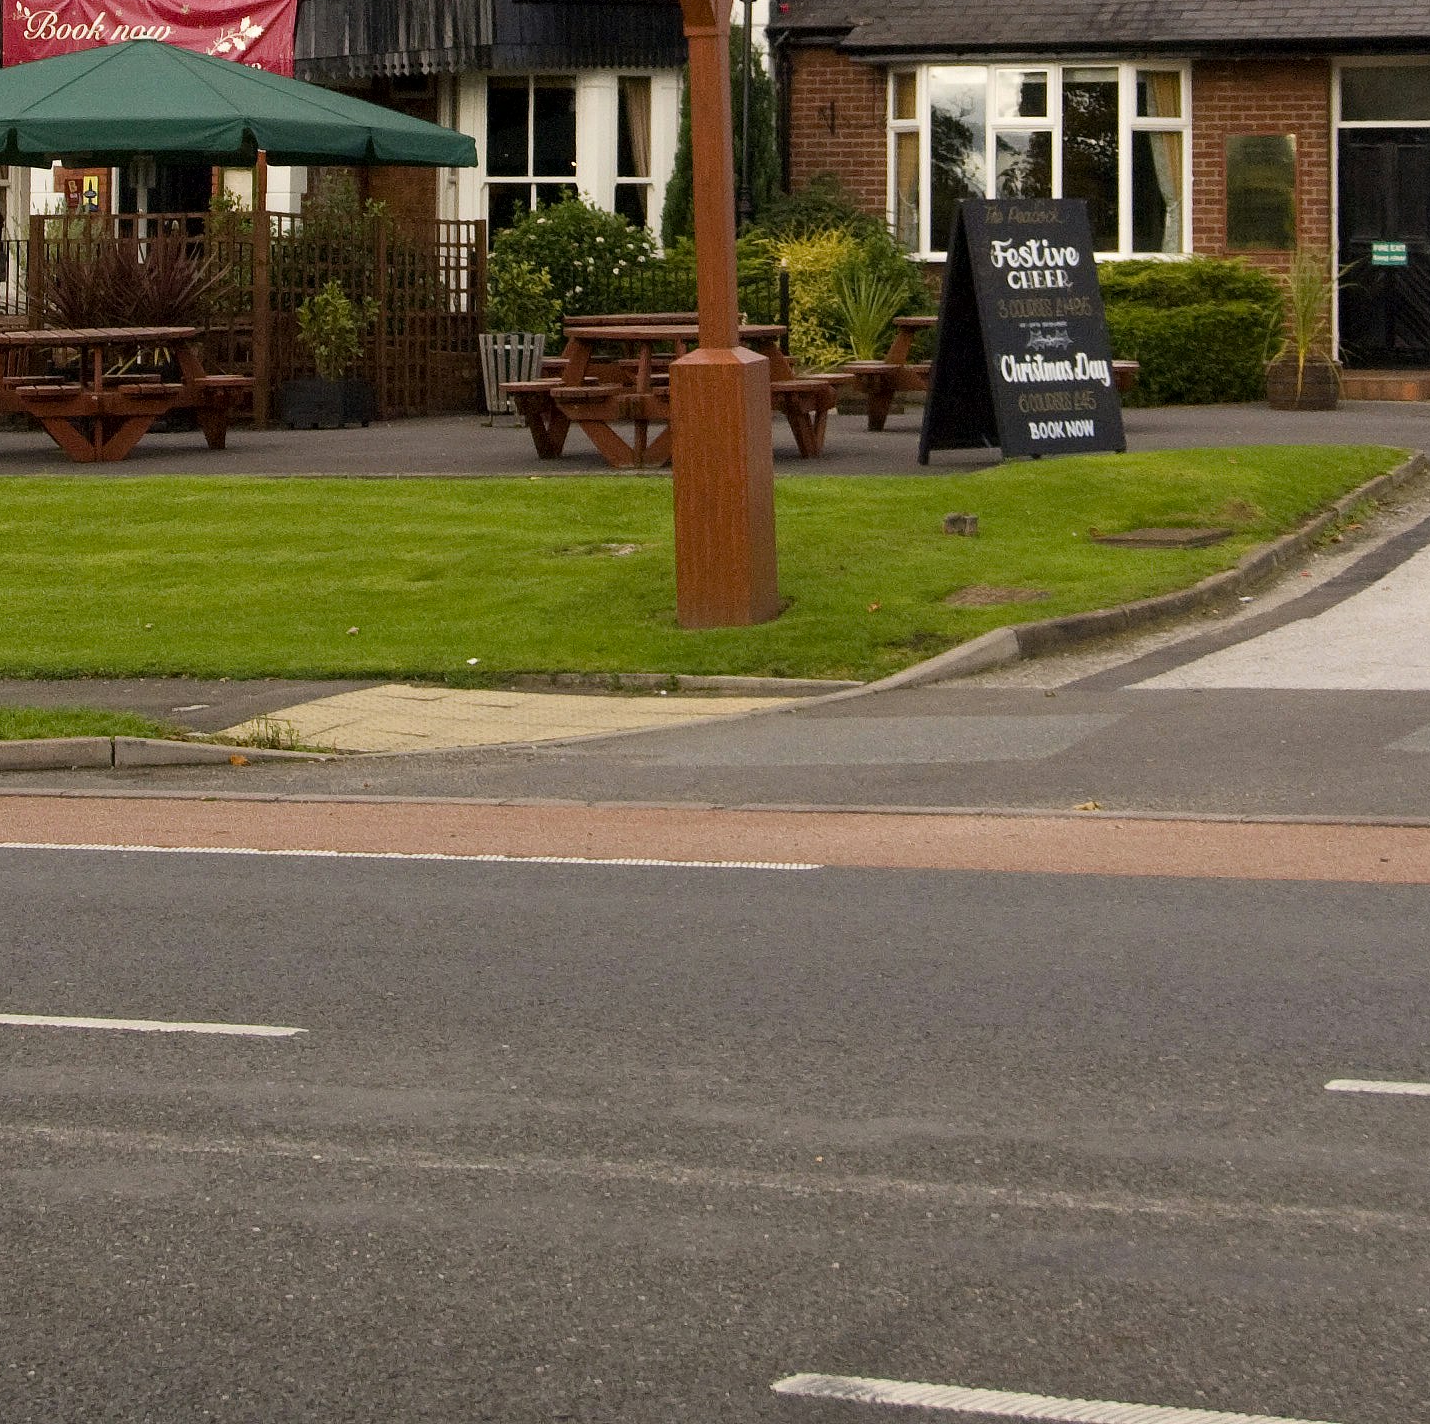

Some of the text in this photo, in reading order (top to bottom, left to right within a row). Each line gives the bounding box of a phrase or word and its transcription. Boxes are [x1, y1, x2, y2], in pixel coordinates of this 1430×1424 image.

[23, 10, 172, 41] Book now
[991, 238, 1080, 268] Festive
[1007, 269, 1074, 290] CHEER
[1001, 352, 1111, 387] Christmas Day
[1028, 419, 1095, 440] BOOK NOW
